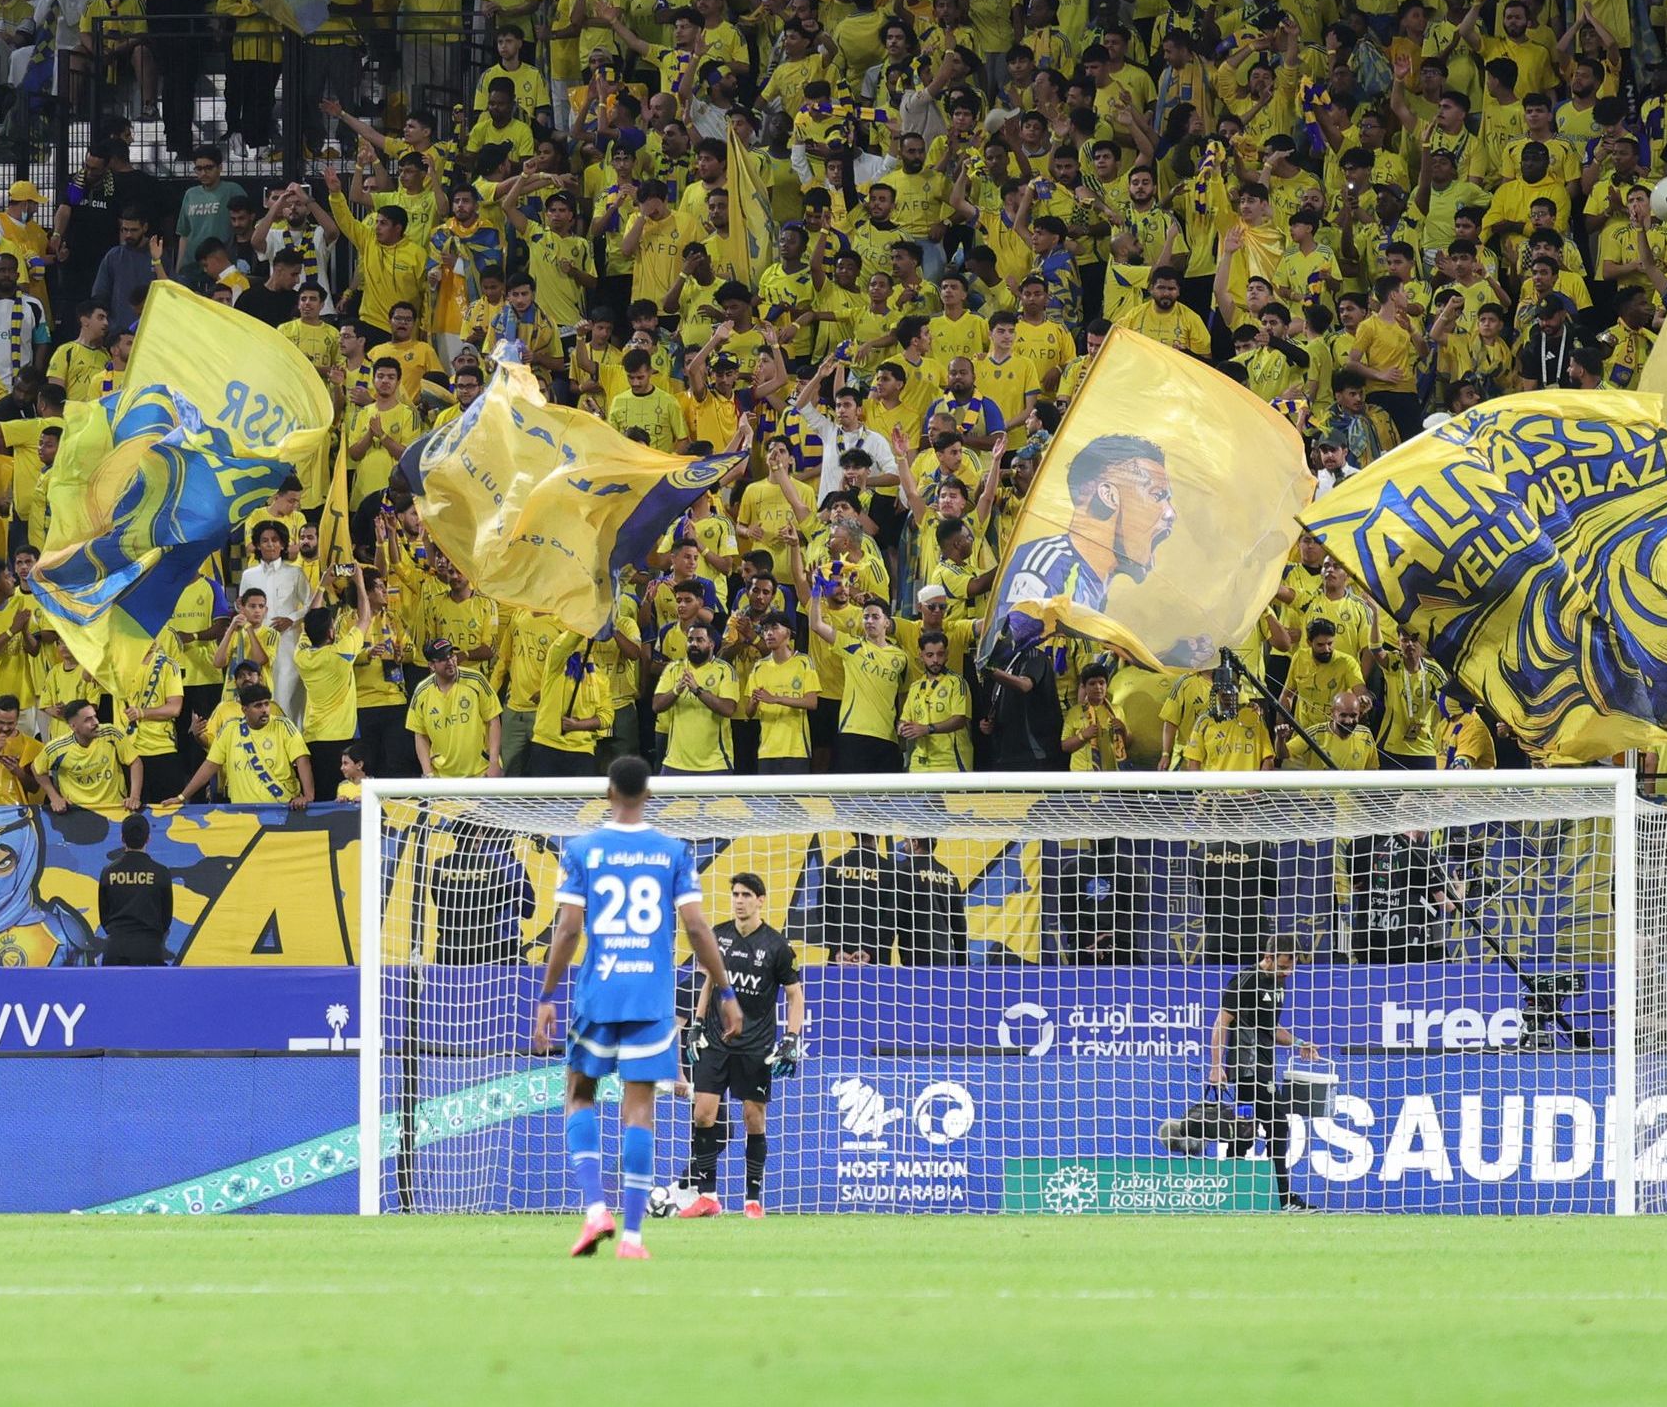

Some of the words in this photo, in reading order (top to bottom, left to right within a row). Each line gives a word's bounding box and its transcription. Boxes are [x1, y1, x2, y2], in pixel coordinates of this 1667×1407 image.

[516, 96, 534, 107] FD
[188, 203, 220, 215] WAKE
[412, 213, 429, 224] FD
[940, 344, 972, 353] KAFD
[1018, 348, 1054, 360] KAFD
[314, 353, 329, 366] FD
[74, 374, 91, 384] KA
[448, 633, 477, 645] AFD
[606, 663, 625, 674] FD
[861, 662, 898, 682] KAFD
[434, 713, 470, 729] KAFD
[1216, 743, 1254, 755] KAFD
[235, 758, 274, 771] KAD
[77, 770, 112, 784] KAFD
[1205, 849, 1250, 865] Police
[110, 872, 155, 886] POLICE
[442, 868, 490, 881] POLICE
[836, 867, 879, 881] POLICE
[592, 874, 663, 936] 28
[603, 937, 650, 950] KANNO
[614, 961, 654, 974] SEVEN
[1068, 1002, 1201, 1031] التعاونية
[1383, 1002, 1524, 1048] tree
[837, 1161, 889, 1179] HOST
[895, 1161, 969, 1180] NATION
[842, 1184, 894, 1202] SAUDI
[899, 1184, 965, 1202] ARABIA
[1109, 1192, 1166, 1208] ROSHN
[1168, 1192, 1228, 1208] GROUP
